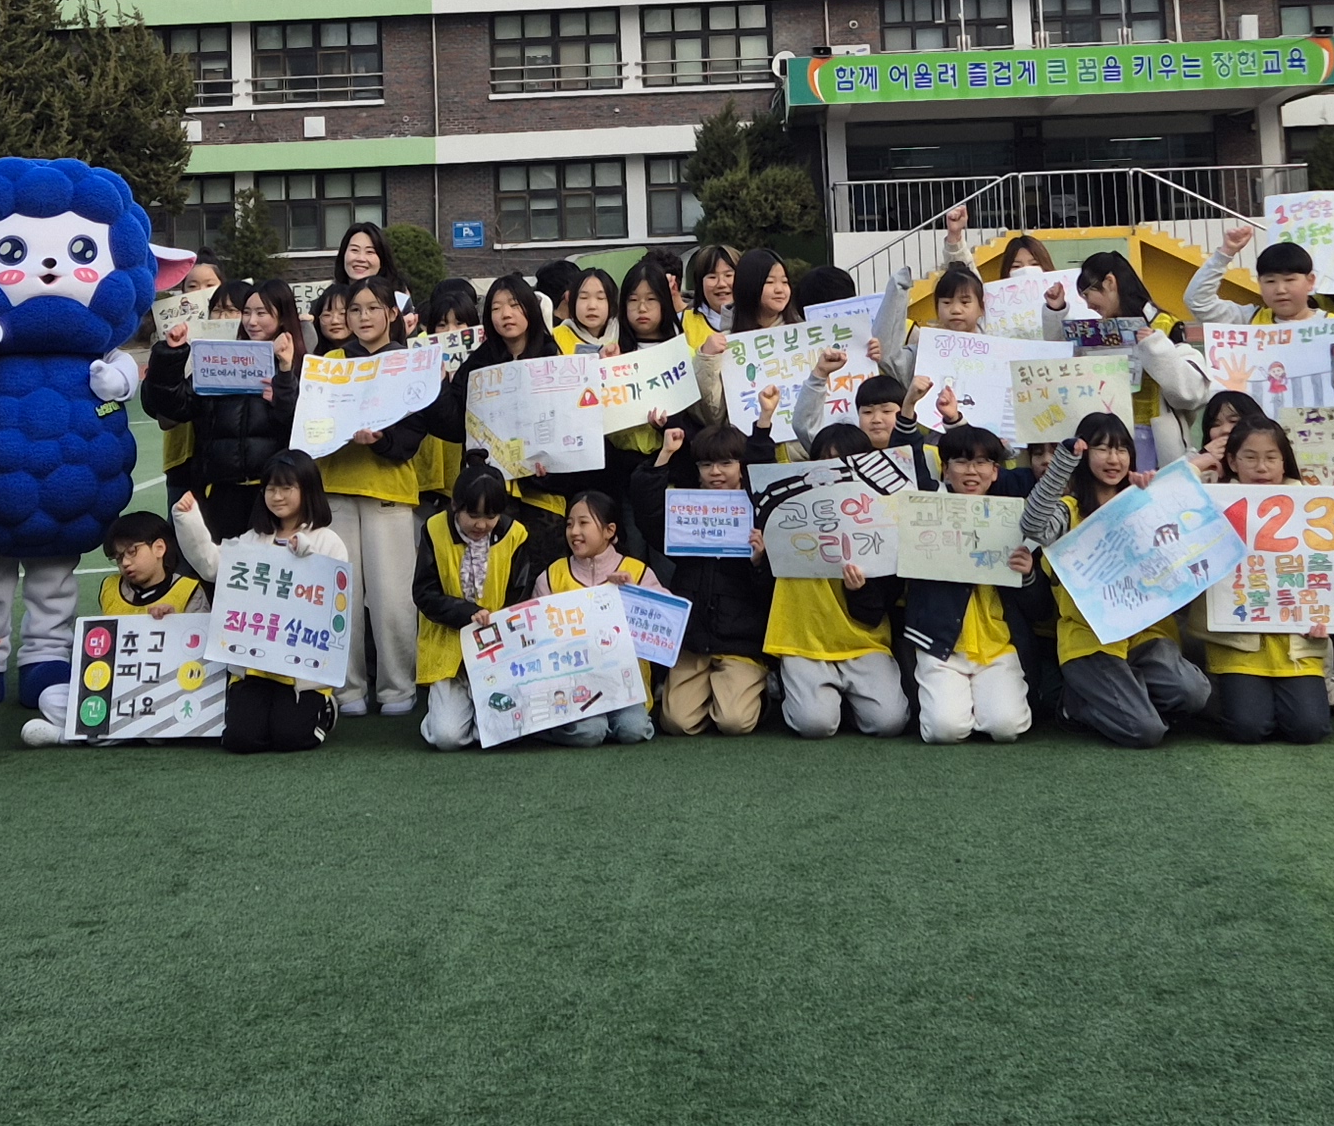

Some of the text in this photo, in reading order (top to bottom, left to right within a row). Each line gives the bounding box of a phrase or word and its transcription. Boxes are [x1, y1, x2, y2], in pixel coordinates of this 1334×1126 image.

[834, 64, 879, 92] 함께
[888, 62, 959, 90] 어울려
[967, 60, 1038, 88] 즐겁게
[1047, 59, 1067, 85] 큰
[1076, 57, 1122, 85] 꿈을
[1132, 53, 1202, 82] 키우는
[200, 368, 236, 377] 인도에서
[646, 361, 687, 390] 지켜요
[909, 495, 1022, 529] 교통안전
[791, 531, 885, 563] 우리가
[915, 530, 980, 559] 우리가
[224, 610, 330, 652] 좌우를 살펴요
[545, 604, 587, 637] 횡단
